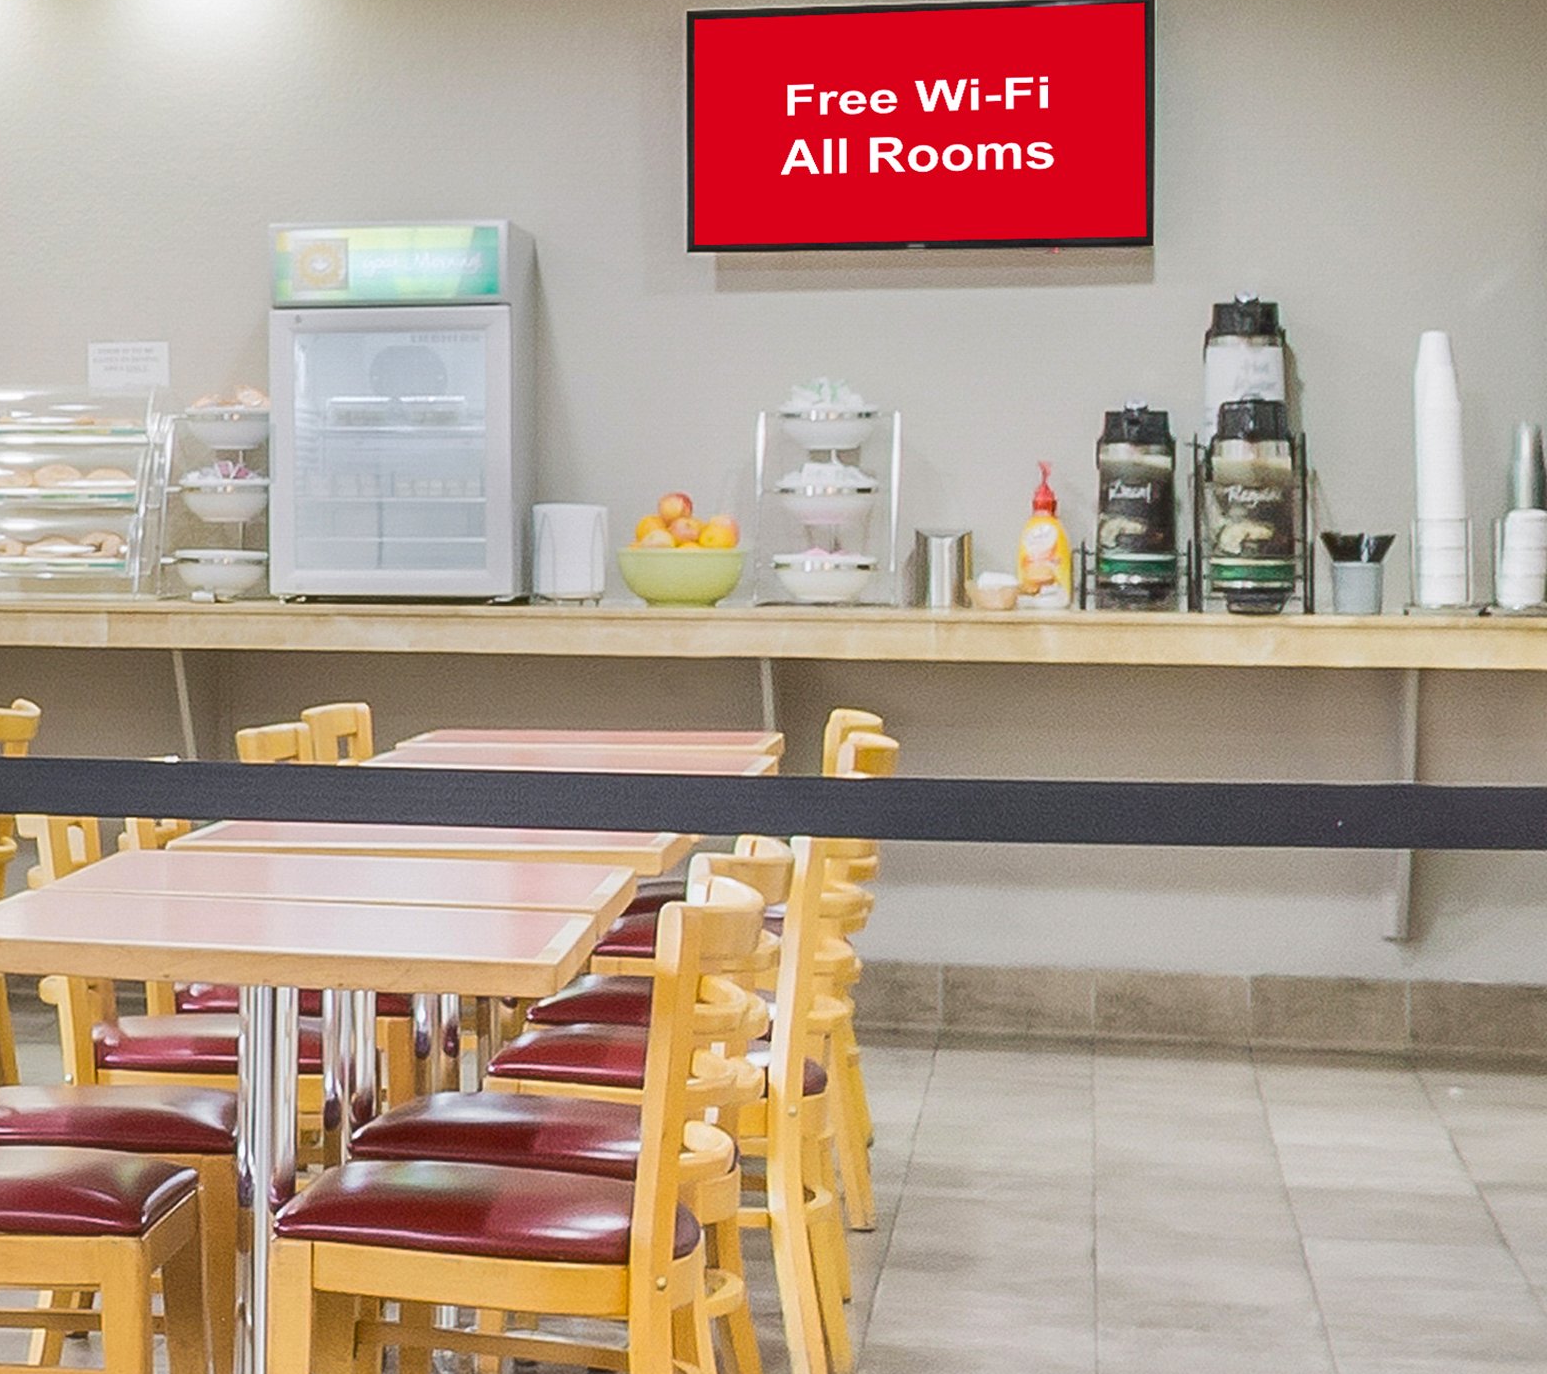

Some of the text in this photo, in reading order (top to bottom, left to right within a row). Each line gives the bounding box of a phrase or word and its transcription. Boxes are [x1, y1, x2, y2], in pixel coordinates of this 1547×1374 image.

[786, 76, 1049, 117] Free Wi-Fi
[780, 136, 1055, 176] All Rooms
